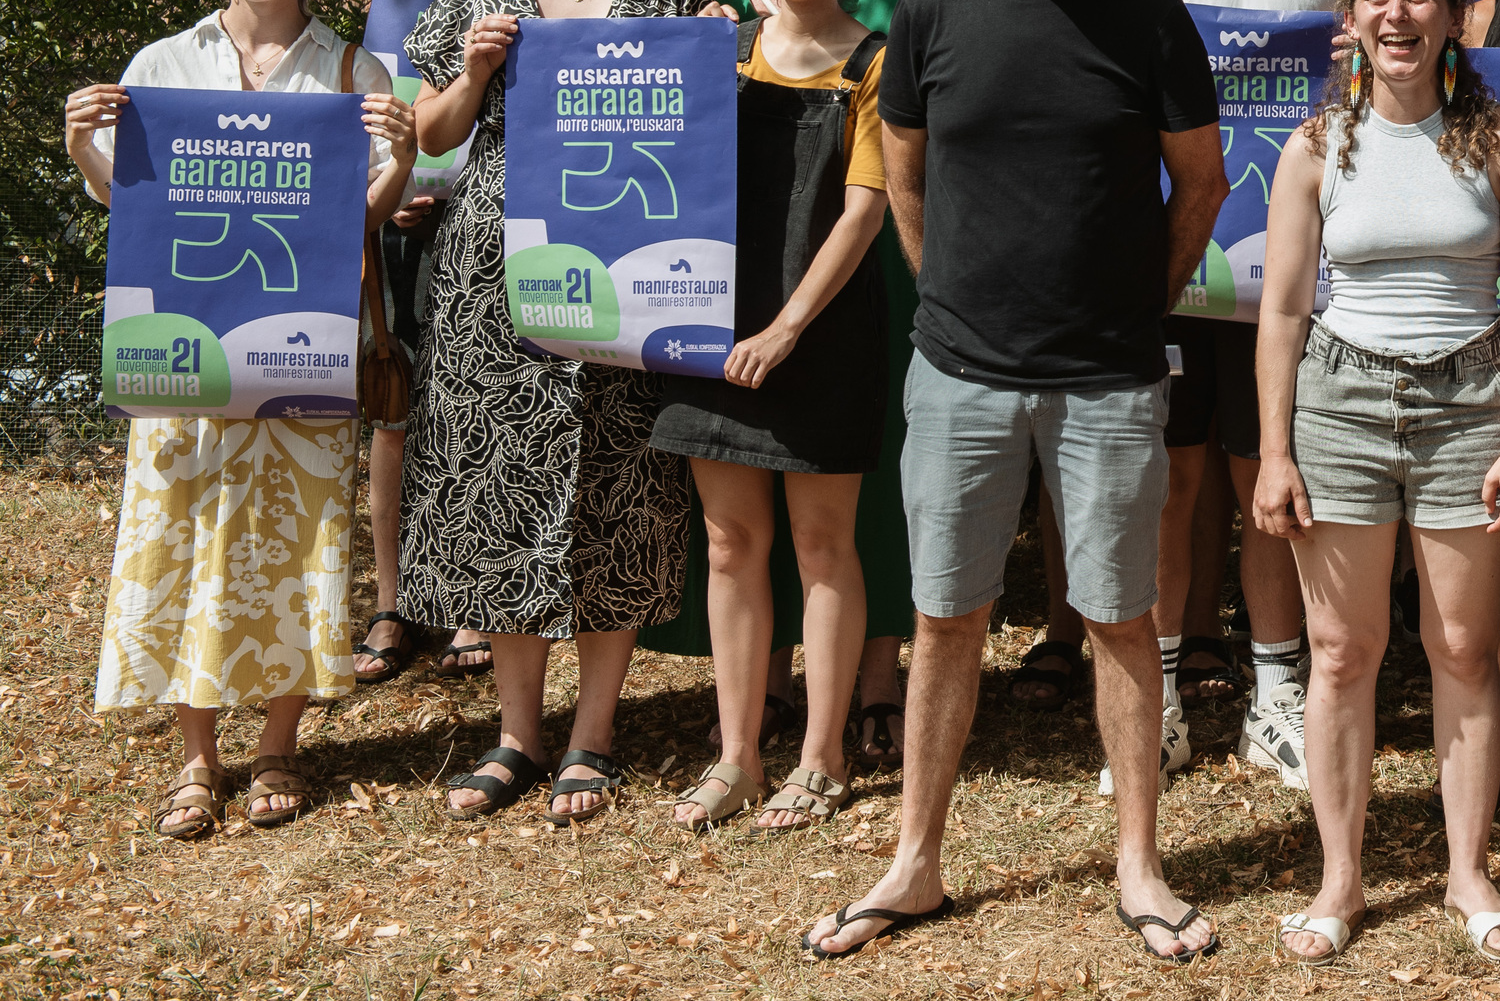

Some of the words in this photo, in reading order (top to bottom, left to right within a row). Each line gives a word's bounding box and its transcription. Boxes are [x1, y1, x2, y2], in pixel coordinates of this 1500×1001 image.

[1208, 56, 1308, 72] skararen
[557, 68, 682, 85] euskararen
[1219, 104, 1247, 118] HOIX,
[556, 118, 589, 132] notre
[171, 138, 312, 158] euskararen
[168, 188, 204, 202] notre
[518, 278, 562, 292] azaroak
[566, 268, 592, 304] 21
[116, 346, 168, 361] azaroak
[171, 338, 200, 374] 21
